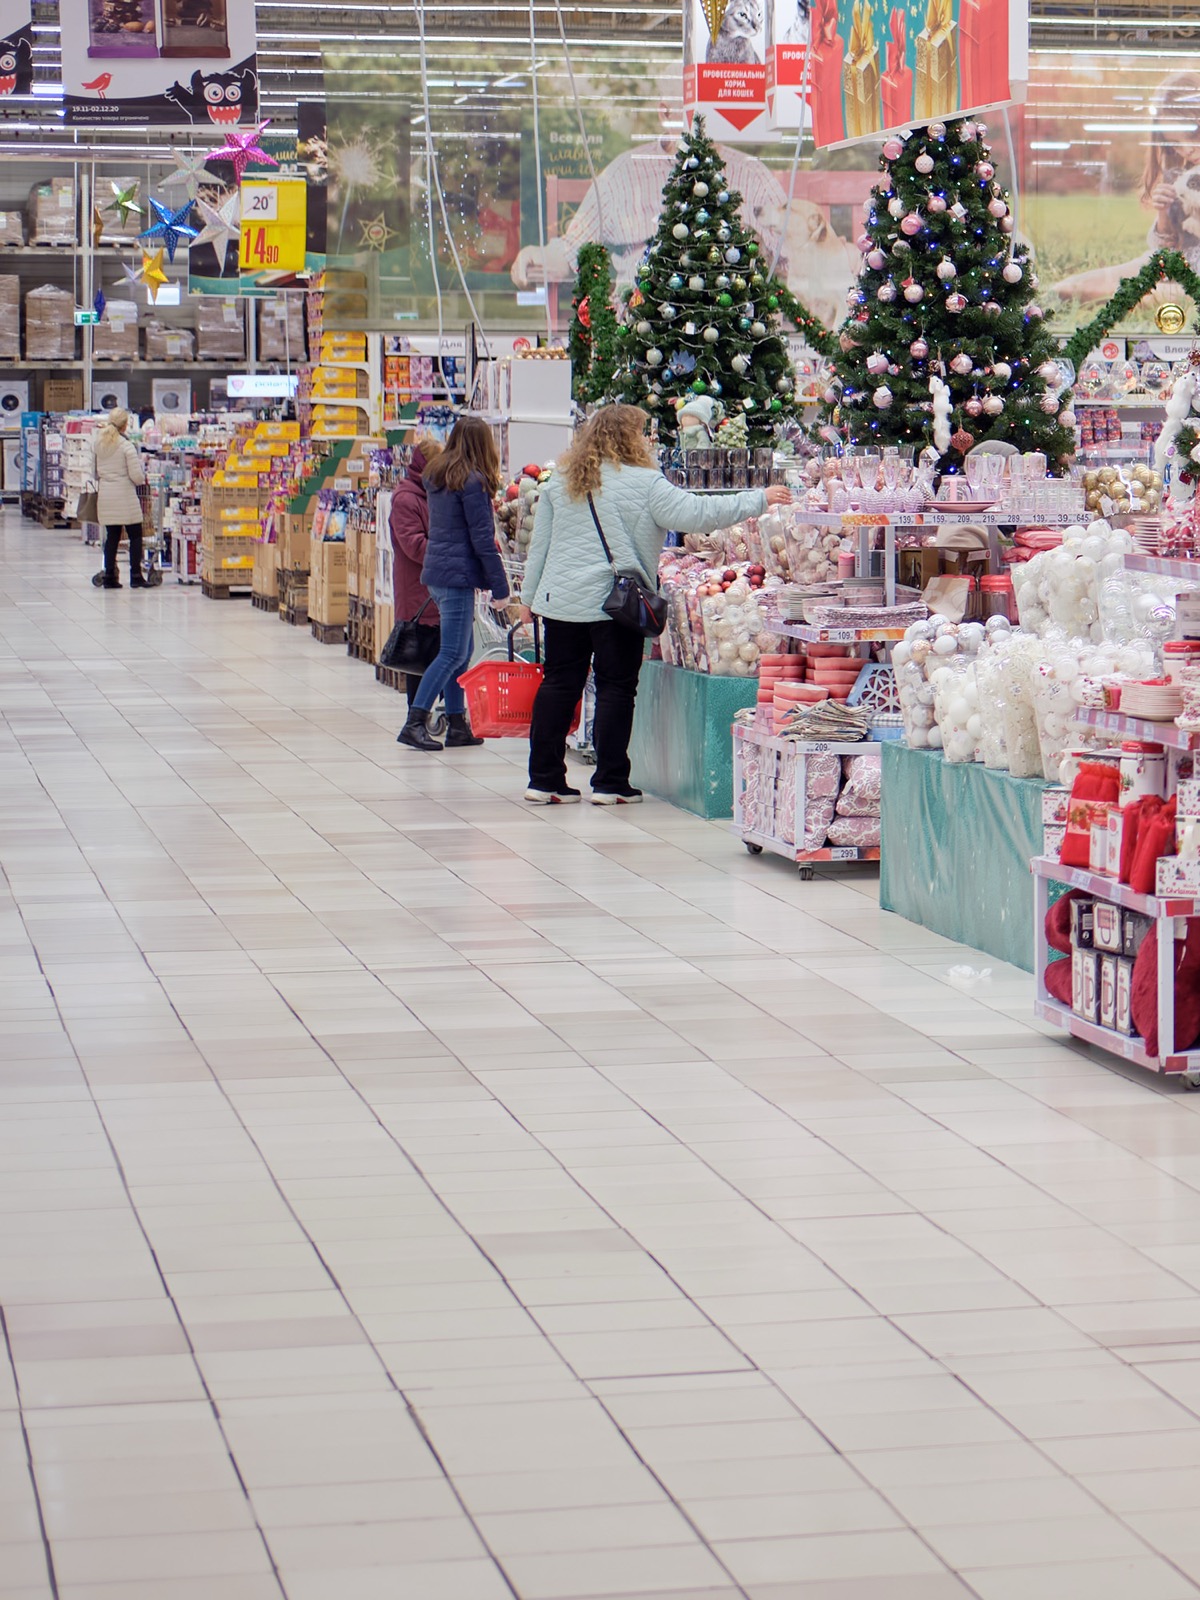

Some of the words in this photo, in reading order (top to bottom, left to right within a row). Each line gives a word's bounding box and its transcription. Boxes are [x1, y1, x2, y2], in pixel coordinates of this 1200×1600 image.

[702, 69, 766, 78] ПРОФЕССИОНАЛЬНЫ
[724, 80, 747, 88] КОРМА
[717, 89, 731, 98] ДЛЯ
[732, 89, 755, 97] КОШЕК
[253, 196, 269, 210] 20
[244, 227, 266, 264] 14
[899, 515, 912, 524] 139
[932, 515, 945, 523] 159
[957, 515, 970, 523] 209
[982, 515, 995, 523] 219
[1007, 514, 1020, 523] 289
[1032, 514, 1045, 523] 139
[1057, 514, 1068, 523] 39
[837, 631, 851, 640] 109
[815, 743, 828, 752] 209
[841, 849, 854, 858] 299
[1165, 887, 1198, 896] Christmas
